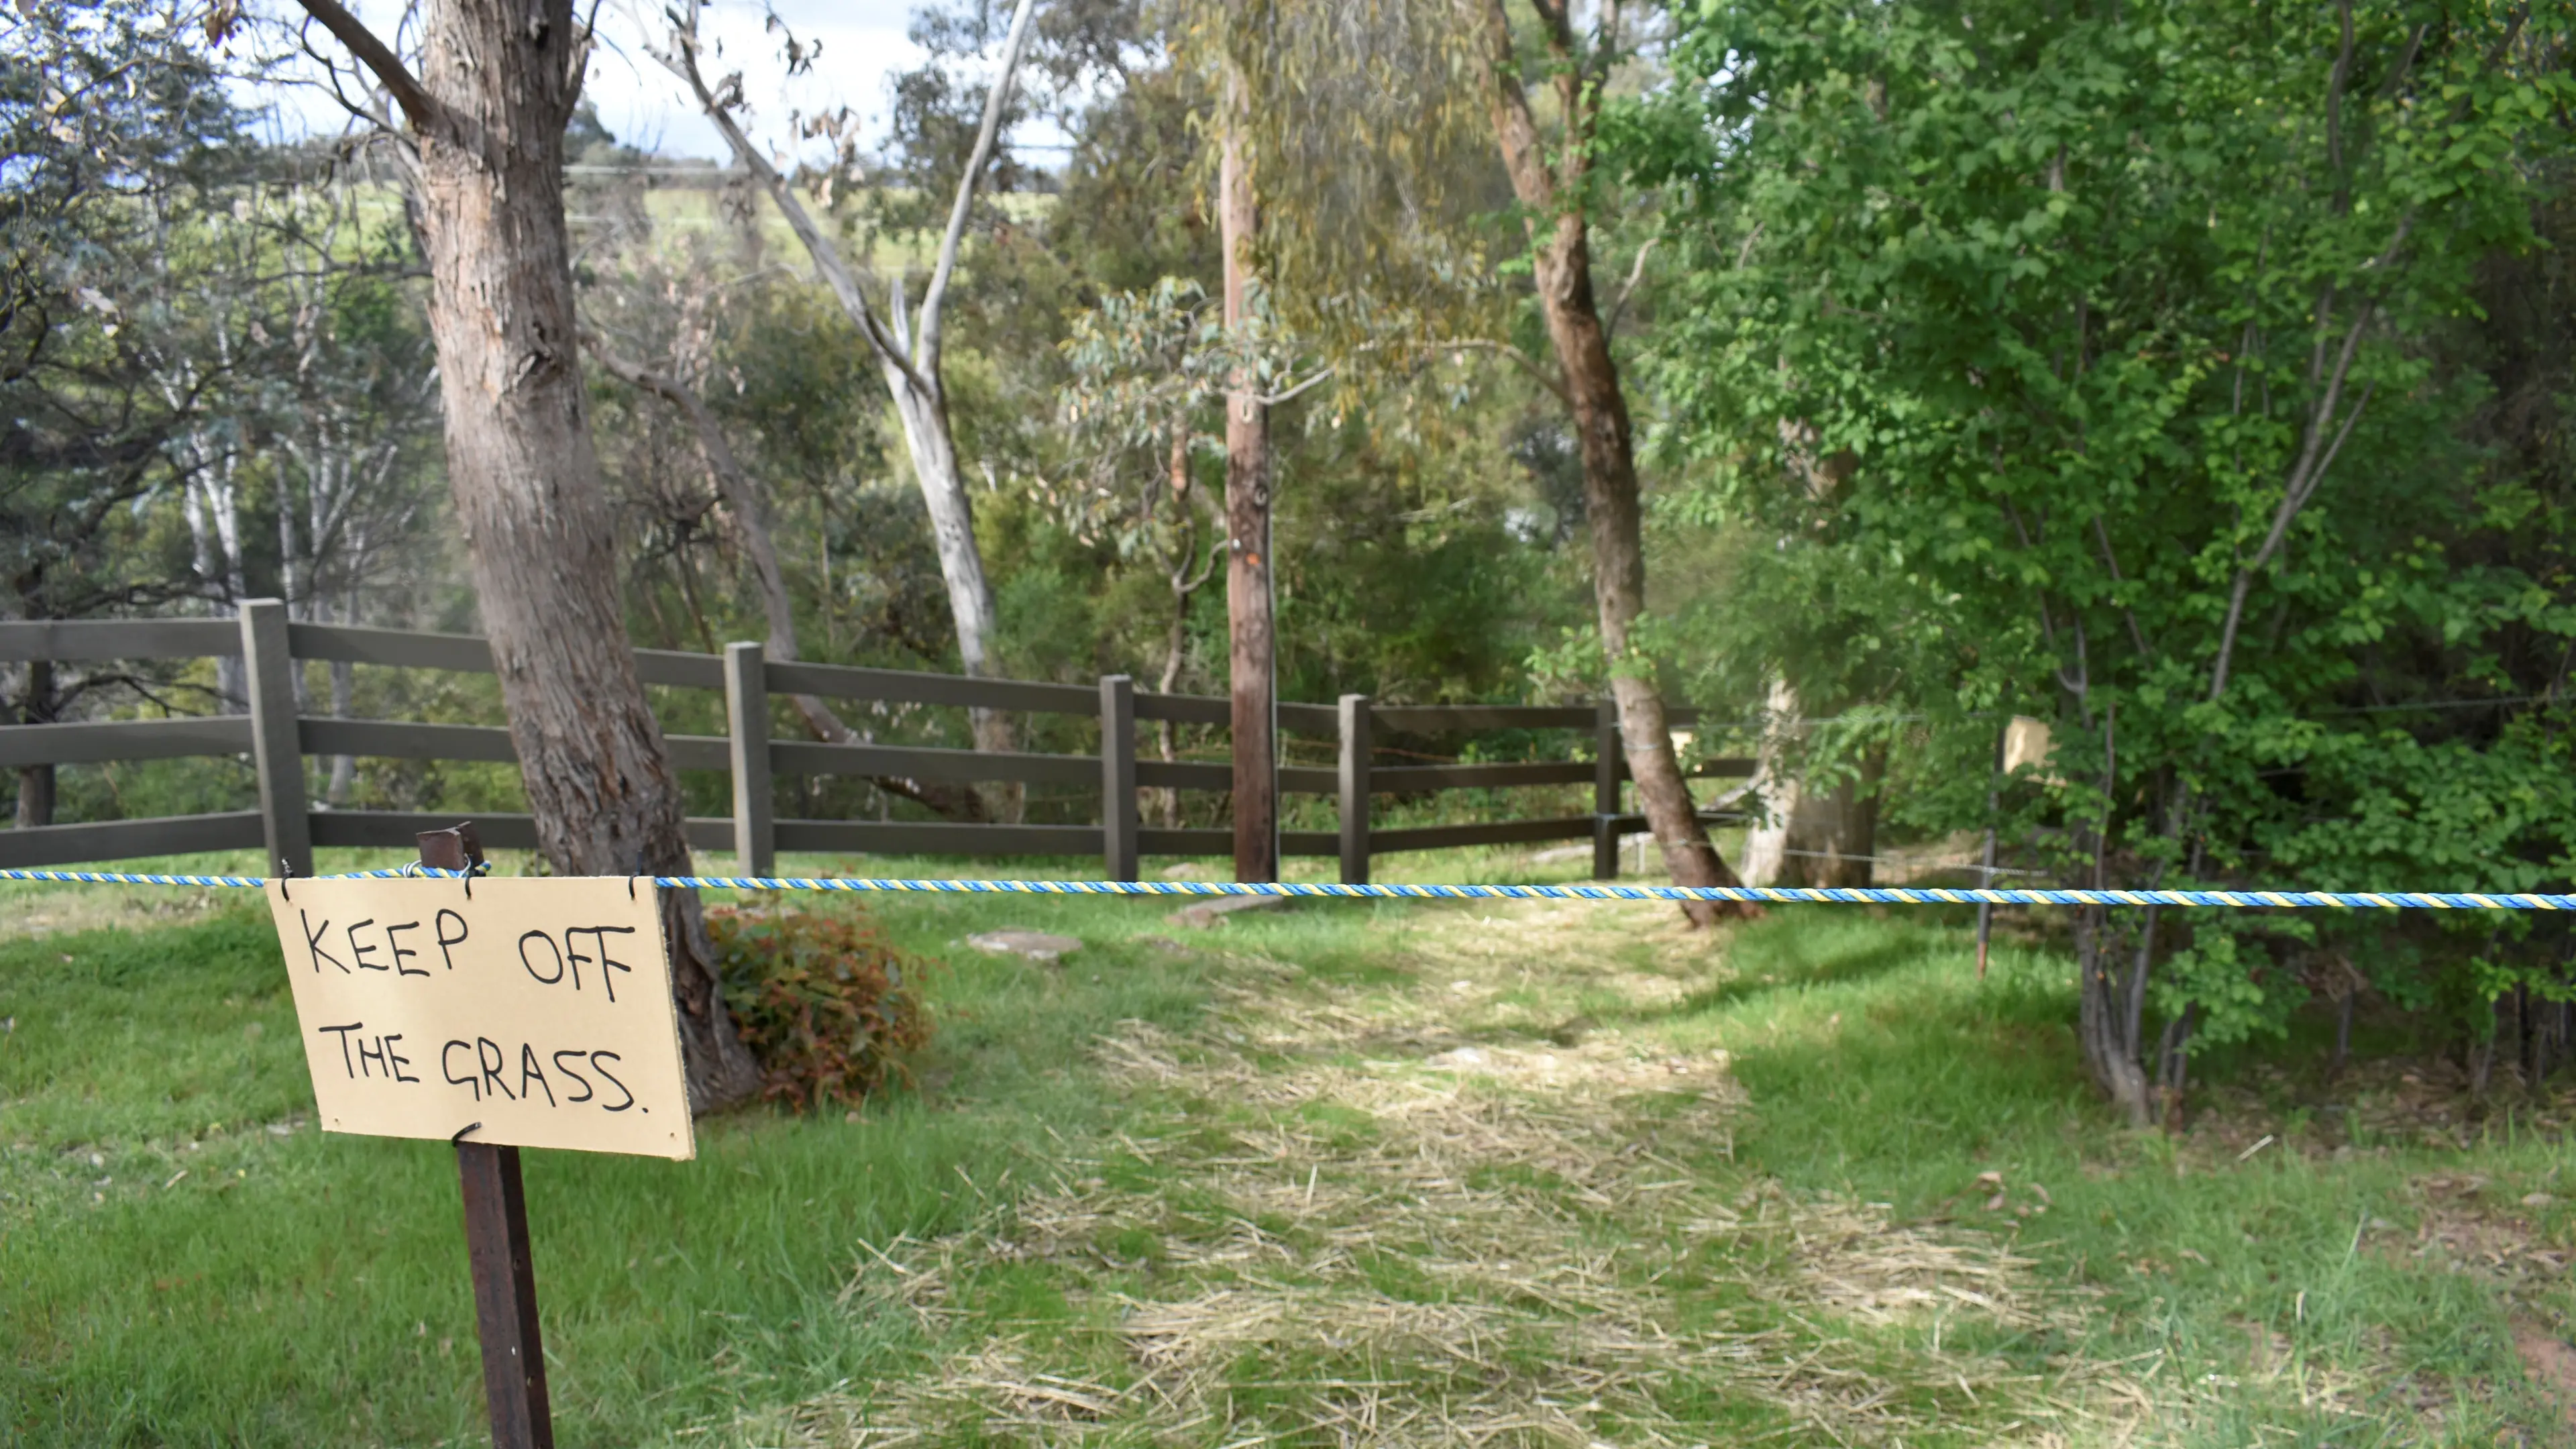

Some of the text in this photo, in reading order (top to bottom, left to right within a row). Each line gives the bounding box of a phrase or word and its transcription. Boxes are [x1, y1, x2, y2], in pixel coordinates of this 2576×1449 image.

[300, 908, 636, 1003] KEEP OFF
[318, 1022, 649, 1114] THE GRASS.
